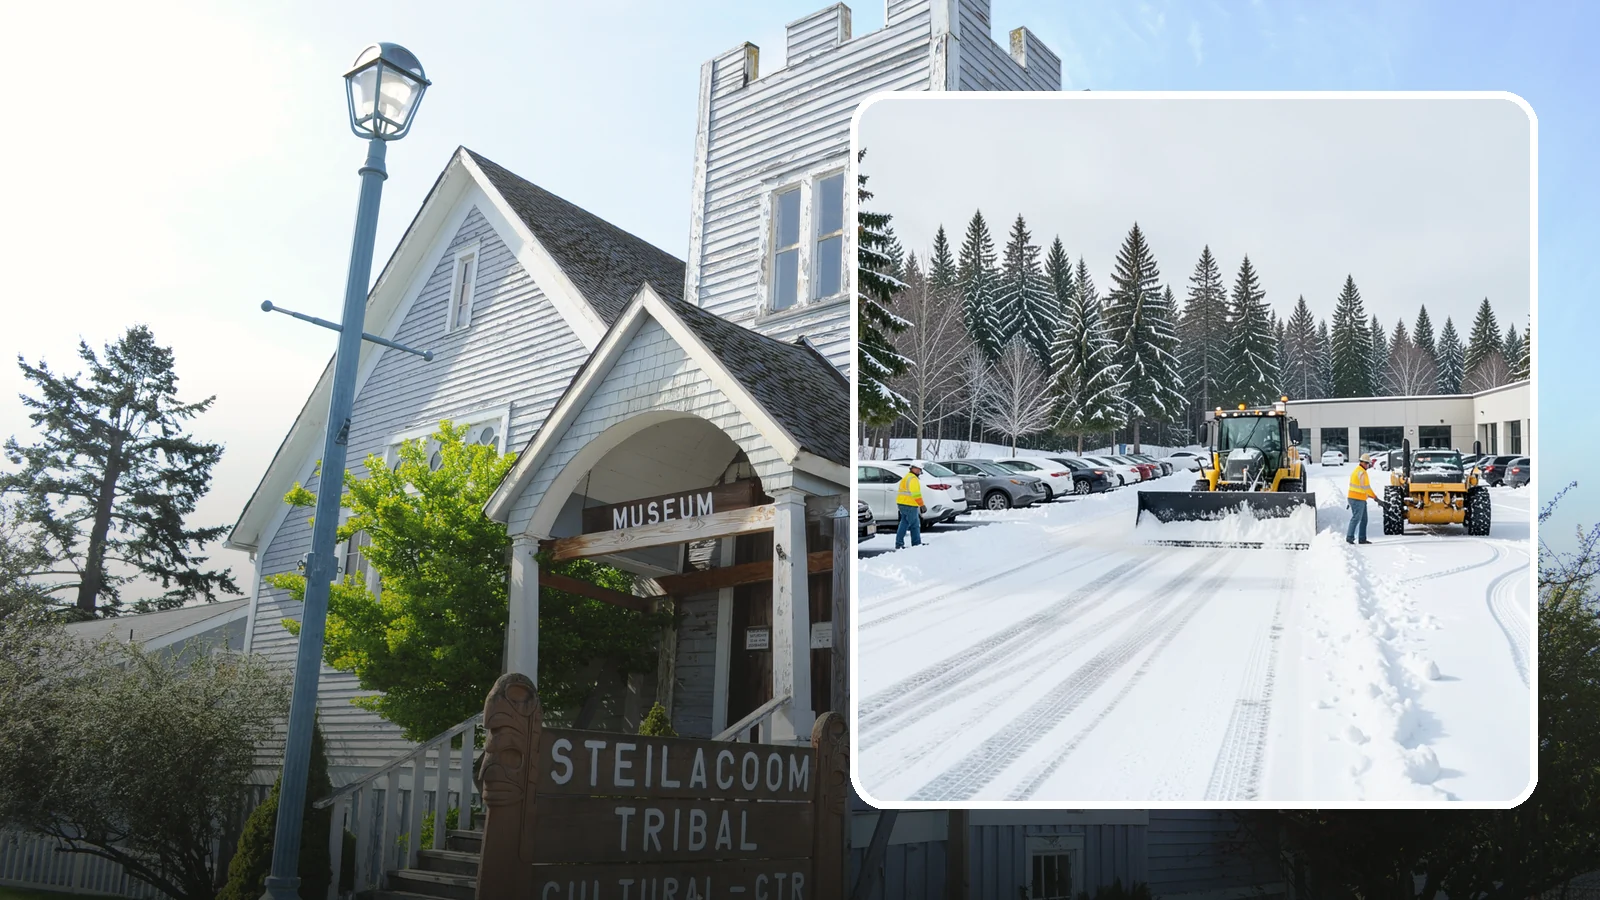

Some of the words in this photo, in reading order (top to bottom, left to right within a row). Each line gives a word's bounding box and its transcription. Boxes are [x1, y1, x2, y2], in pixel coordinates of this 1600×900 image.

[613, 491, 713, 531] MUSEUM
[550, 738, 810, 793] STEILACOOM
[614, 806, 758, 852] TRIBAL
